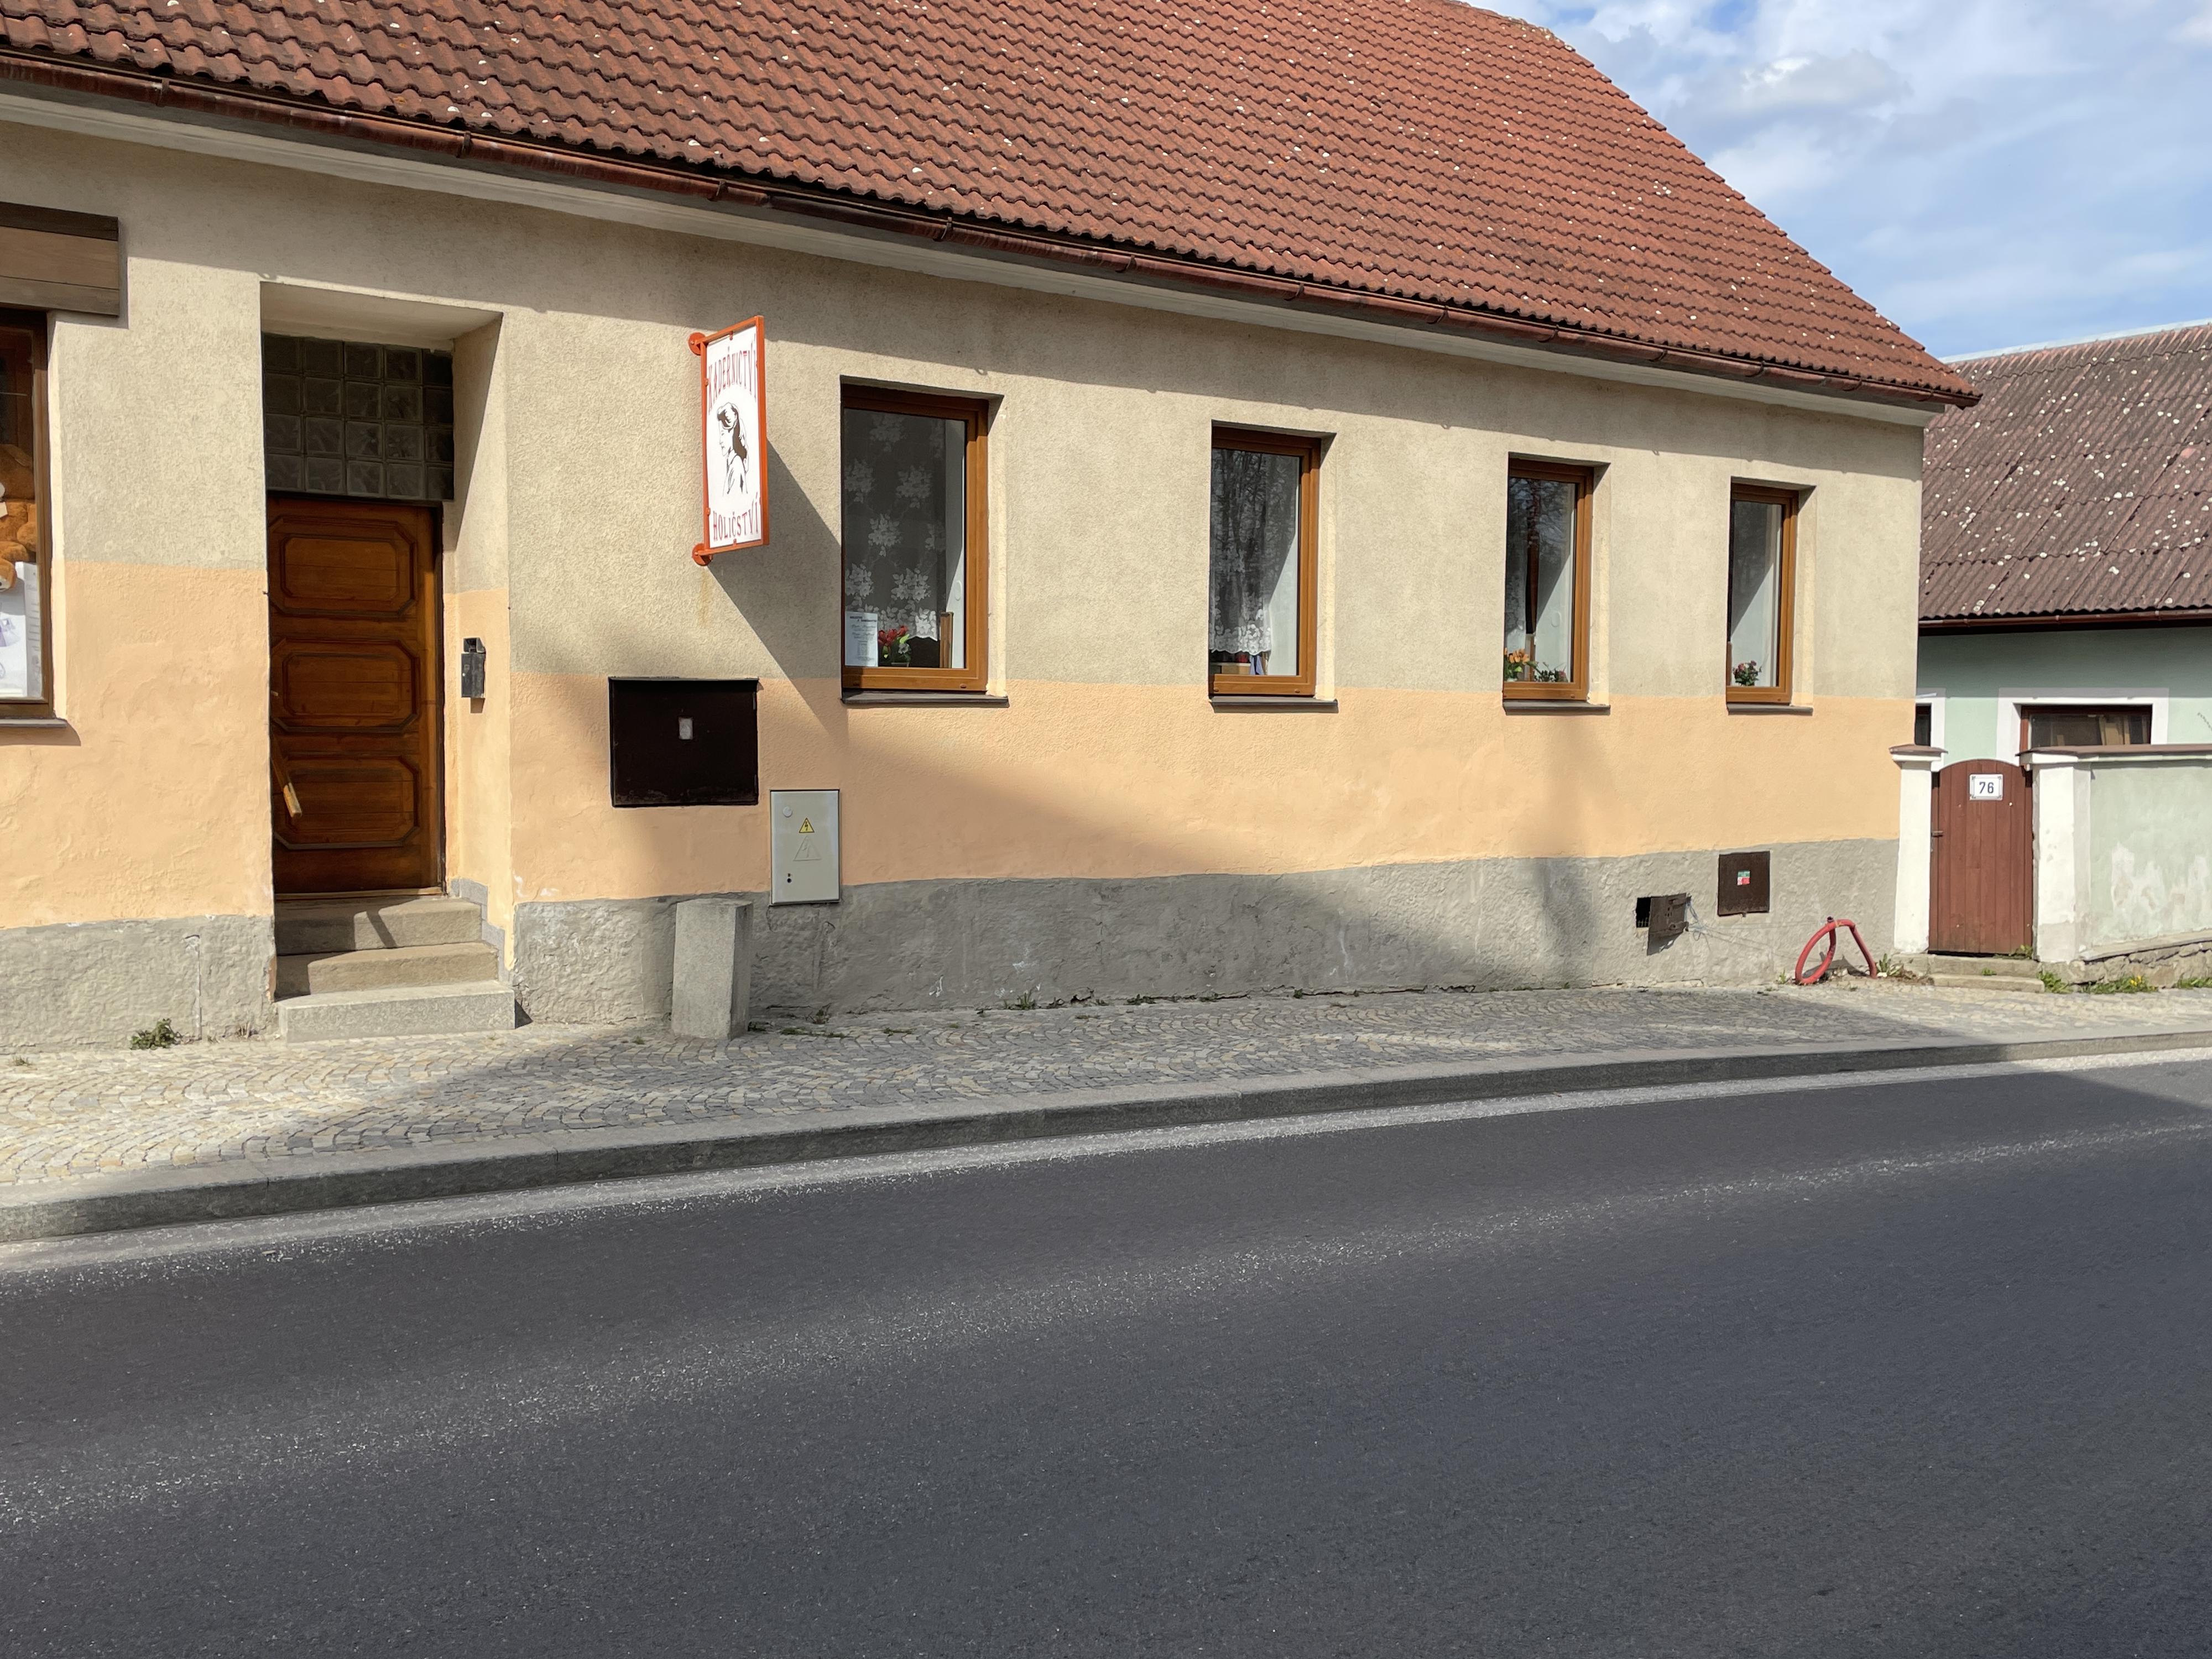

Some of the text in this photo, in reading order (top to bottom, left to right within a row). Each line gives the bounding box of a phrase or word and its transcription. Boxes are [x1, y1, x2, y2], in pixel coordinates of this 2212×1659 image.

[709, 333, 756, 415] KADEŘNICTVÍ
[713, 492, 758, 541] HOLIČSTVÍ
[1979, 781, 1994, 794] 76
